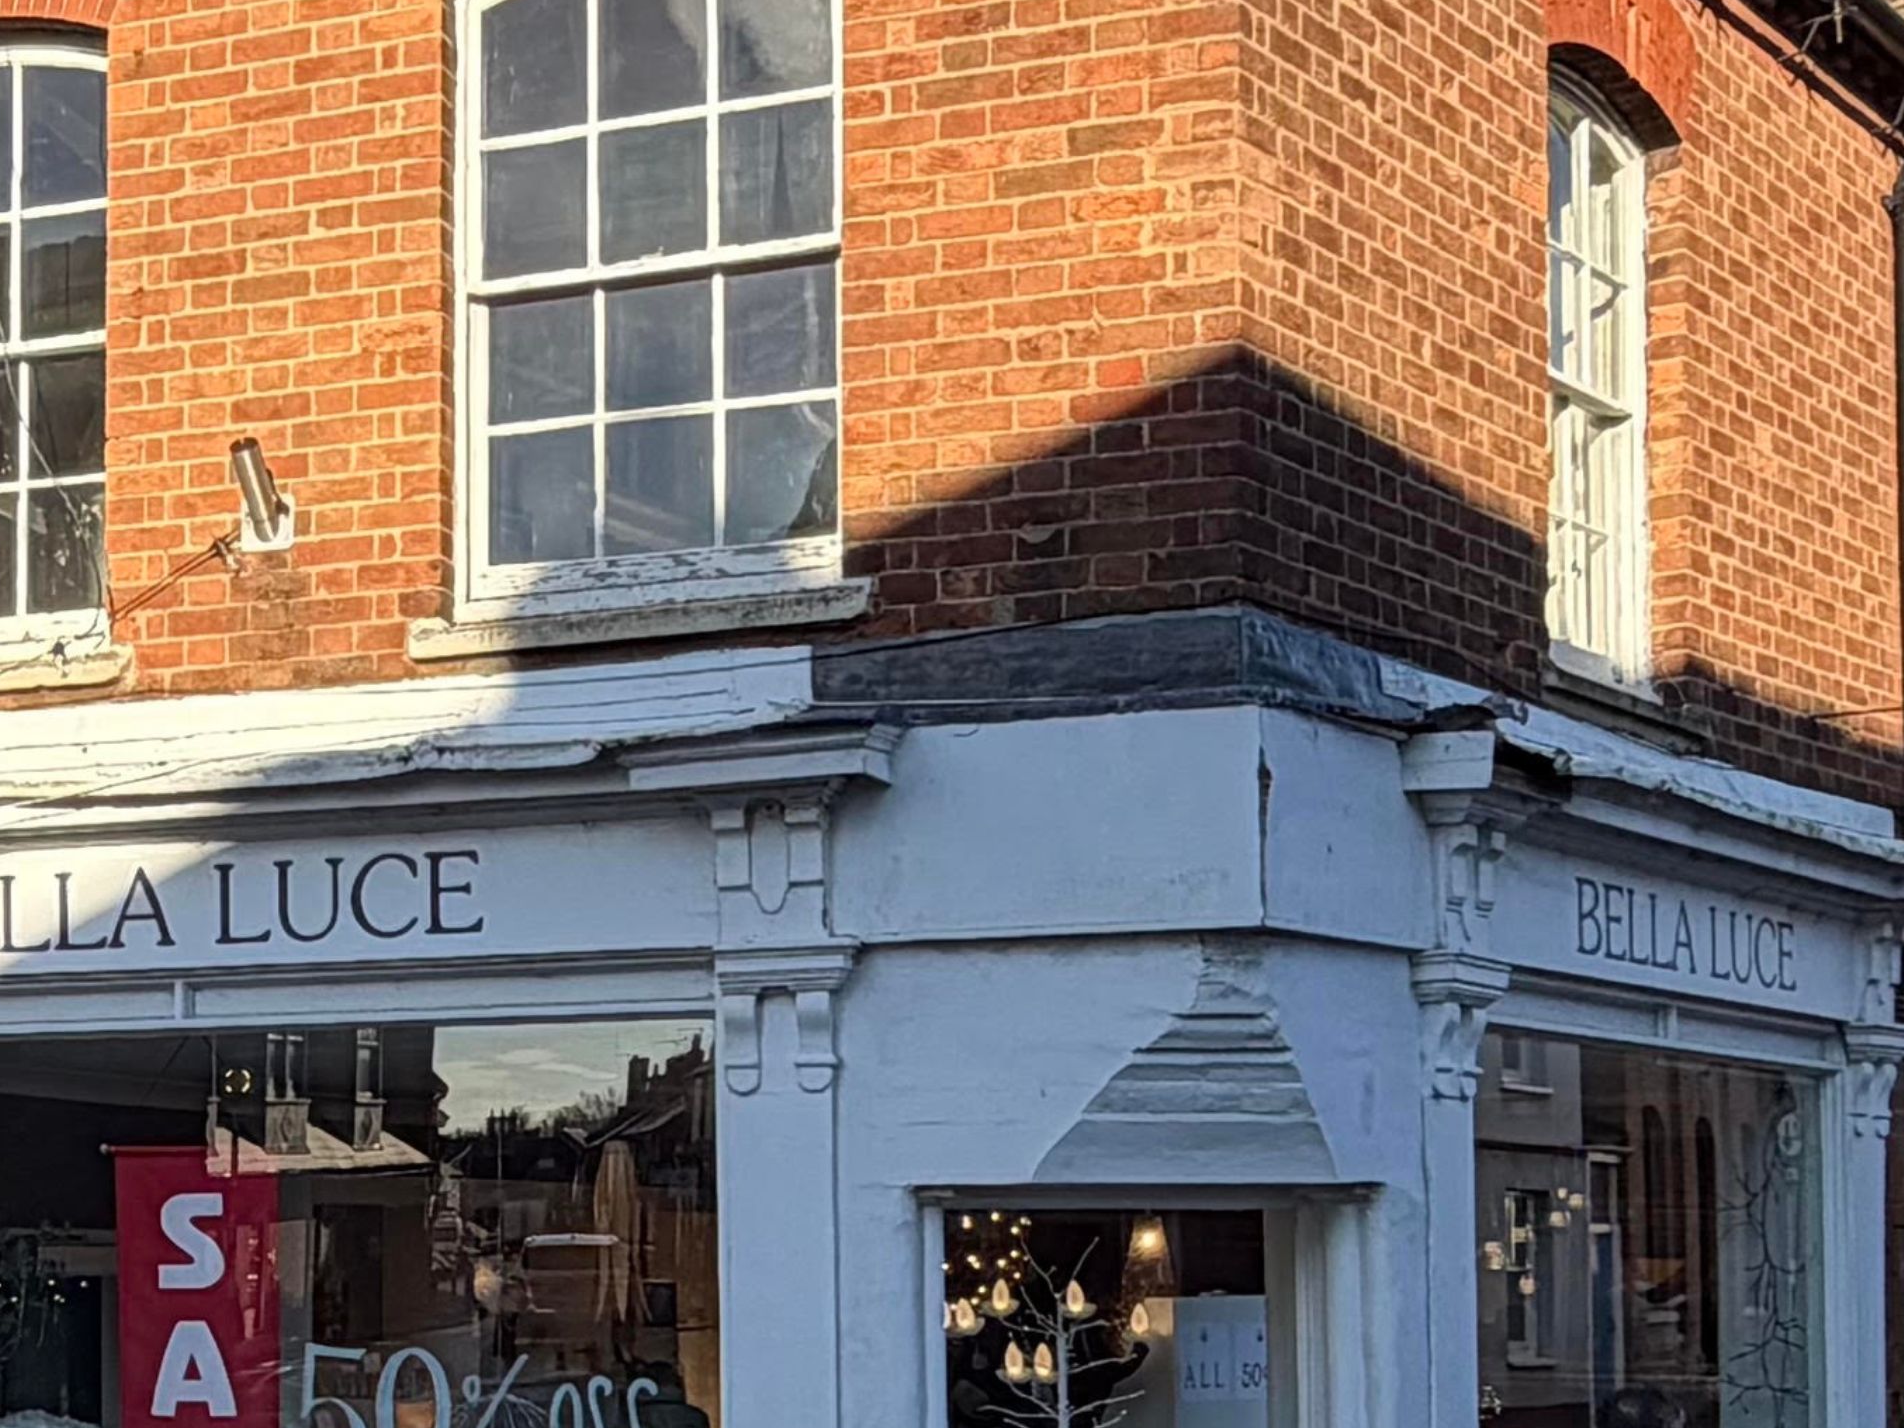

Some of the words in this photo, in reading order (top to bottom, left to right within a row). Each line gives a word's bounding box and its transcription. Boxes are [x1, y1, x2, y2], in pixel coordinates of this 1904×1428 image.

[214, 850, 484, 945] LUCE
[1575, 876, 1697, 975] BELLA
[1709, 905, 1797, 992] LUCE
[1184, 1361, 1226, 1389] ALL
